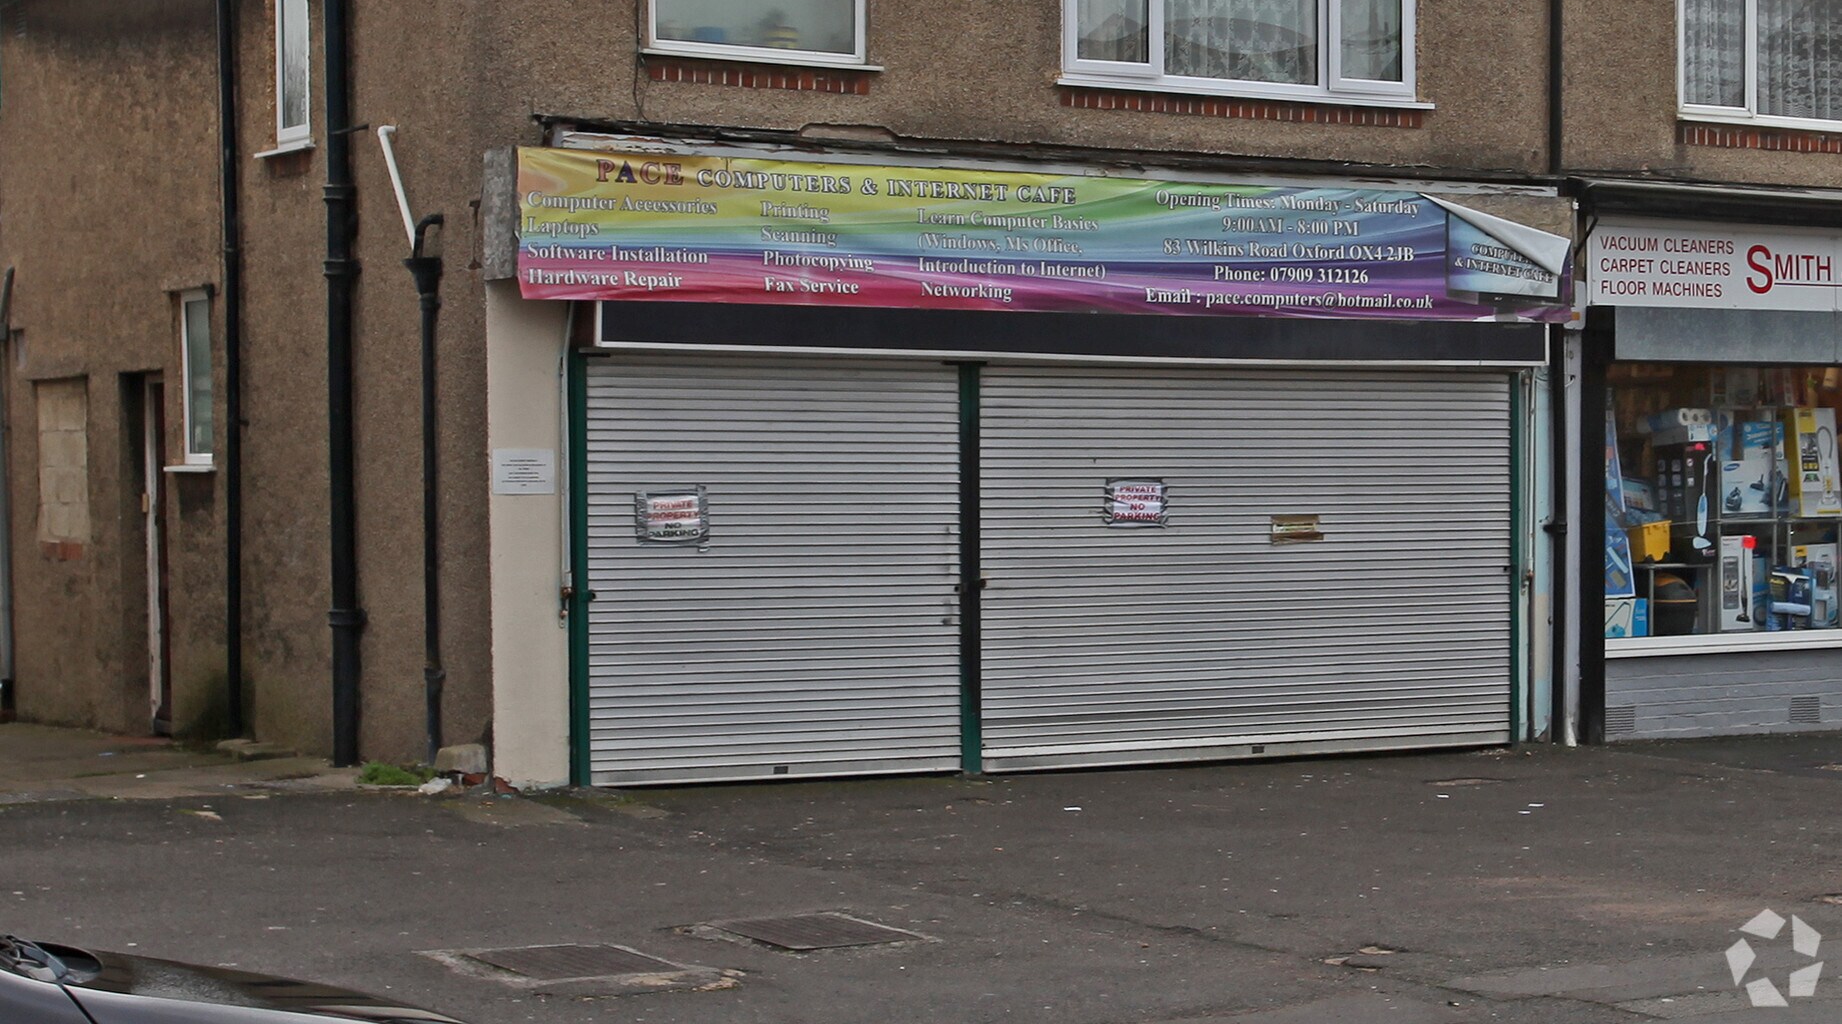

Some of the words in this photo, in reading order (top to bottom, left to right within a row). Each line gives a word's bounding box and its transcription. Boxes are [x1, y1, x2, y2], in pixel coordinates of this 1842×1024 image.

[596, 158, 684, 185] PACE
[696, 168, 851, 194] COMPUTERS
[861, 178, 878, 196] &
[887, 179, 1008, 201] INTERNET
[1017, 185, 1076, 205] CAFE
[527, 191, 616, 212] Computer
[619, 196, 718, 214] Accessories
[761, 201, 830, 223] Printing
[1156, 189, 1221, 211] Opening
[1224, 192, 1276, 209] Times:
[1280, 195, 1341, 216] Monday
[1354, 197, 1420, 218] Saturday
[527, 217, 599, 238] Laptops
[918, 208, 964, 227] Learn
[970, 211, 1048, 231] Computer
[1052, 214, 1098, 231] Basics
[1297, 219, 1328, 235] 8:00
[1333, 221, 1359, 236] PM
[761, 227, 837, 247] Scanning
[917, 233, 1000, 253] (Windows,
[1600, 235, 1658, 252] VACUUM
[1663, 238, 1734, 255] CLEANERS
[528, 242, 606, 261] Software
[611, 245, 709, 264] Installation
[1163, 238, 1181, 254] 83
[1186, 239, 1244, 257] Wilkins
[1248, 241, 1287, 258] Road
[1292, 243, 1345, 260] Oxford
[1349, 245, 1382, 261] OX4
[1386, 246, 1415, 262] 2JB
[763, 251, 874, 272] Photocopying
[918, 257, 1016, 275] Introduction
[1022, 262, 1035, 276] to
[1040, 261, 1106, 280] Internet)
[1455, 257, 1464, 267] &
[1600, 258, 1654, 273] CARPET
[1660, 260, 1731, 276] CLEANERS
[1746, 245, 1831, 294] SMITH
[528, 268, 618, 286] Hardware
[624, 271, 683, 290] Repair
[1213, 265, 1265, 282] Phone:
[1270, 267, 1314, 283] 07909
[1317, 268, 1369, 284] 312126
[764, 277, 794, 293] Fax
[800, 279, 859, 295] Service
[921, 282, 1013, 302] Networking
[1601, 280, 1646, 295] FLOOR
[1652, 282, 1722, 297] MACHINES
[1145, 287, 1191, 304] Email
[1205, 291, 1433, 311] pace.computers@hotmail.co.uk
[1115, 494, 1162, 502] PROPERTY
[1120, 485, 1156, 493] PRIVATE
[653, 500, 693, 509] PRIVATE
[1130, 503, 1145, 511] NO
[646, 511, 699, 521] PROPERTY
[1114, 512, 1160, 521] PARKING
[649, 529, 699, 538] PARKING
